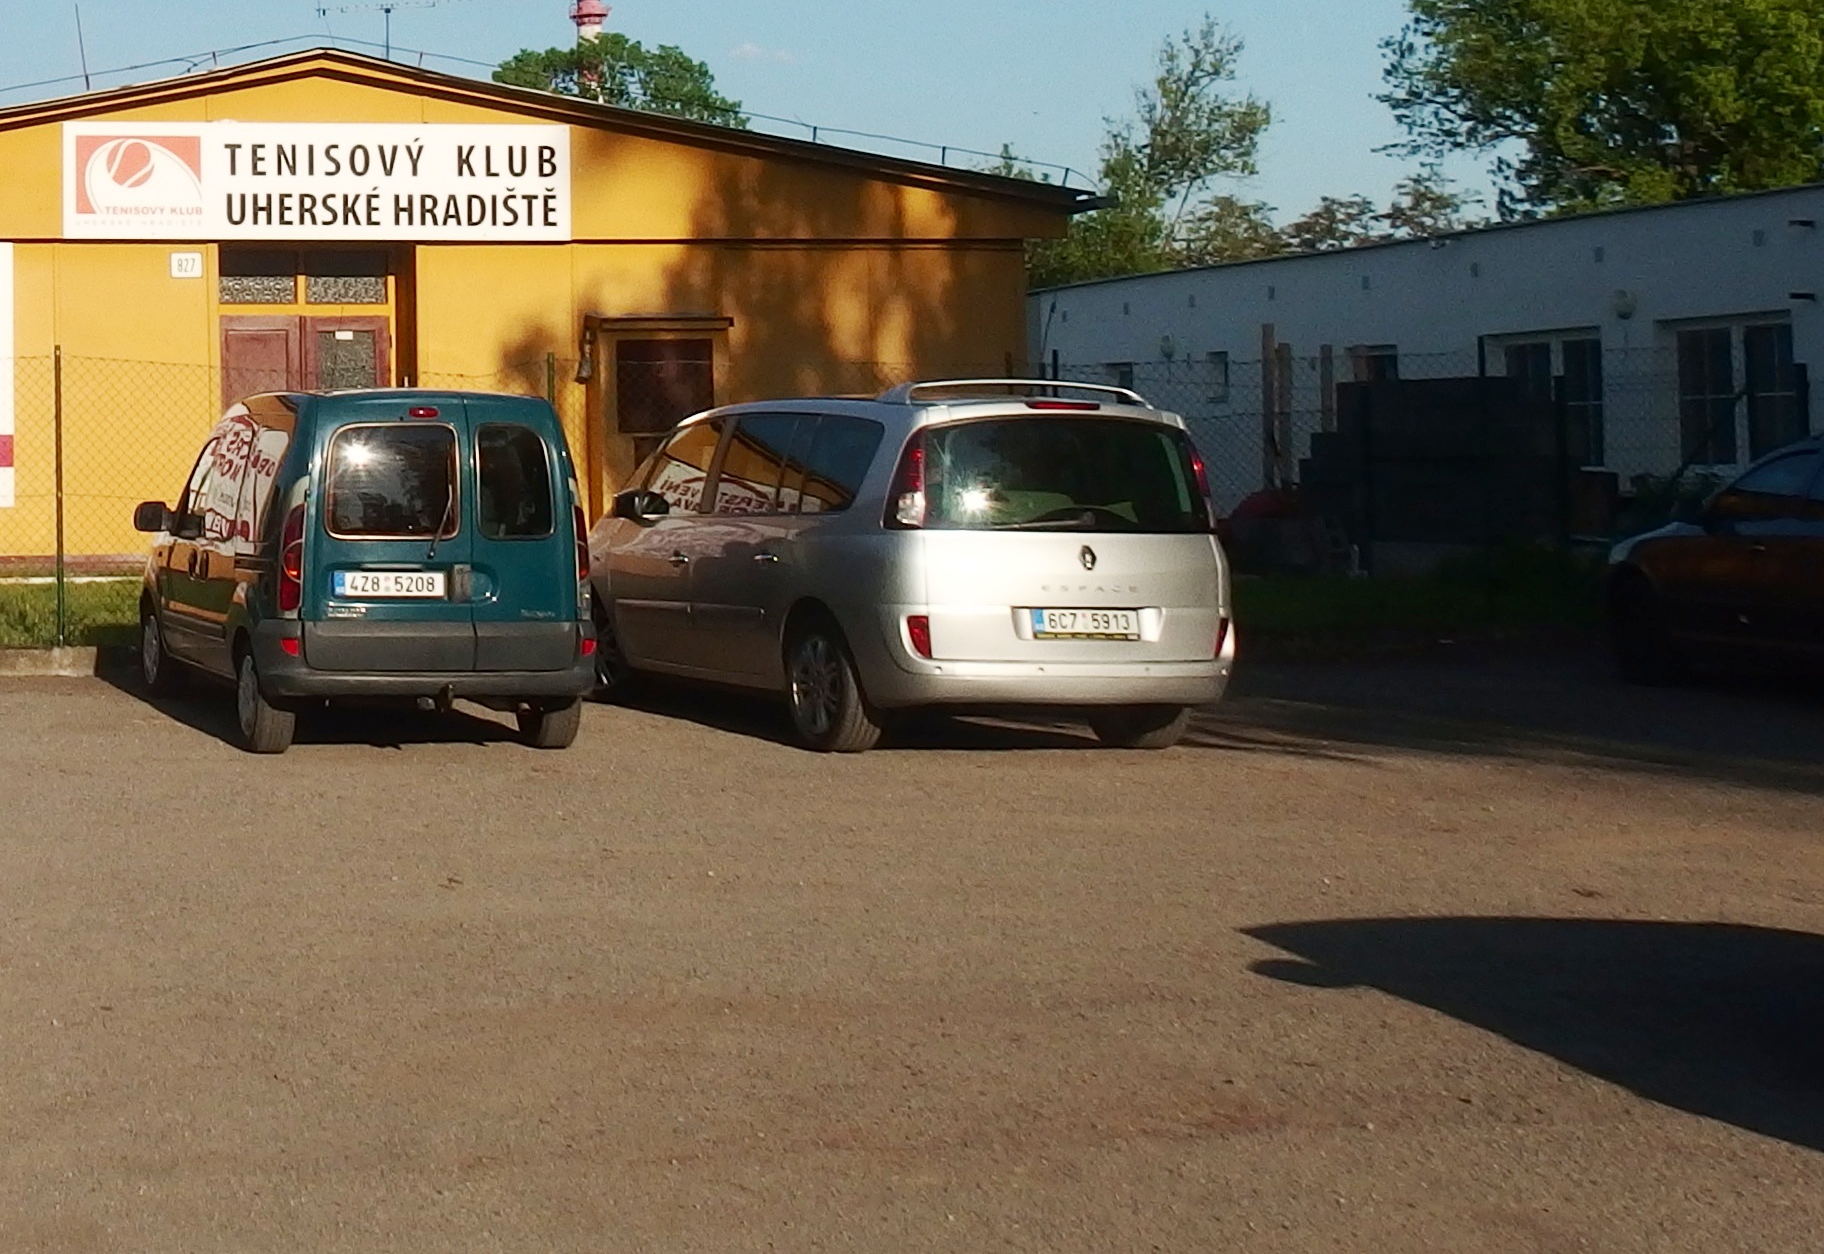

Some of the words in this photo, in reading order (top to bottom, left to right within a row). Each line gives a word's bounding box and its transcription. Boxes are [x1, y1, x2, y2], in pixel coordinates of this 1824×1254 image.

[224, 136, 425, 177] TENISOVÝ
[456, 144, 559, 178] KLUB
[170, 206, 203, 215] KLUB
[226, 187, 381, 227] UHERSKÉ
[394, 187, 559, 228] HRADIŠTĚ
[176, 257, 196, 274] 827
[349, 575, 381, 592] 4Z8
[393, 575, 436, 593] 5208
[1048, 612, 1078, 629] 6C7
[1090, 613, 1130, 631] 5913
